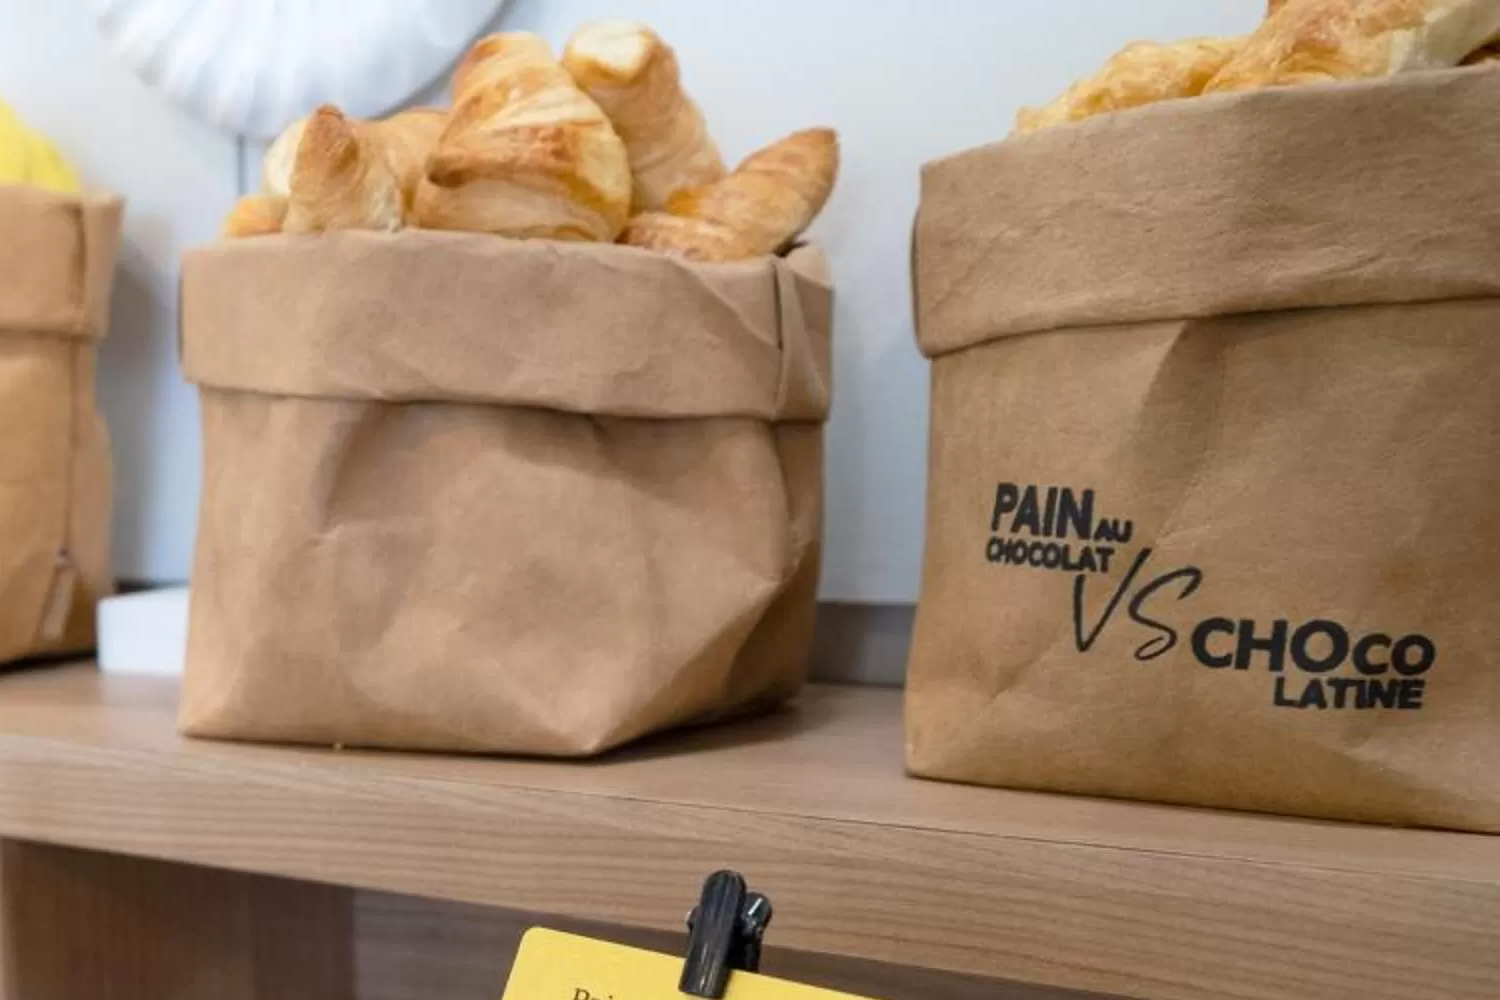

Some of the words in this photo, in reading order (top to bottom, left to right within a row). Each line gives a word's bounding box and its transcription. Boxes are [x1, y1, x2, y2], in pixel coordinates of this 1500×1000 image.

[990, 481, 1096, 541] PAIN
[1094, 518, 1133, 543] AU
[986, 537, 1115, 574] CHOCOLAT
[1072, 547, 1204, 661] VS
[1190, 616, 1436, 677] CHOCO
[1272, 675, 1428, 710] LATINE
